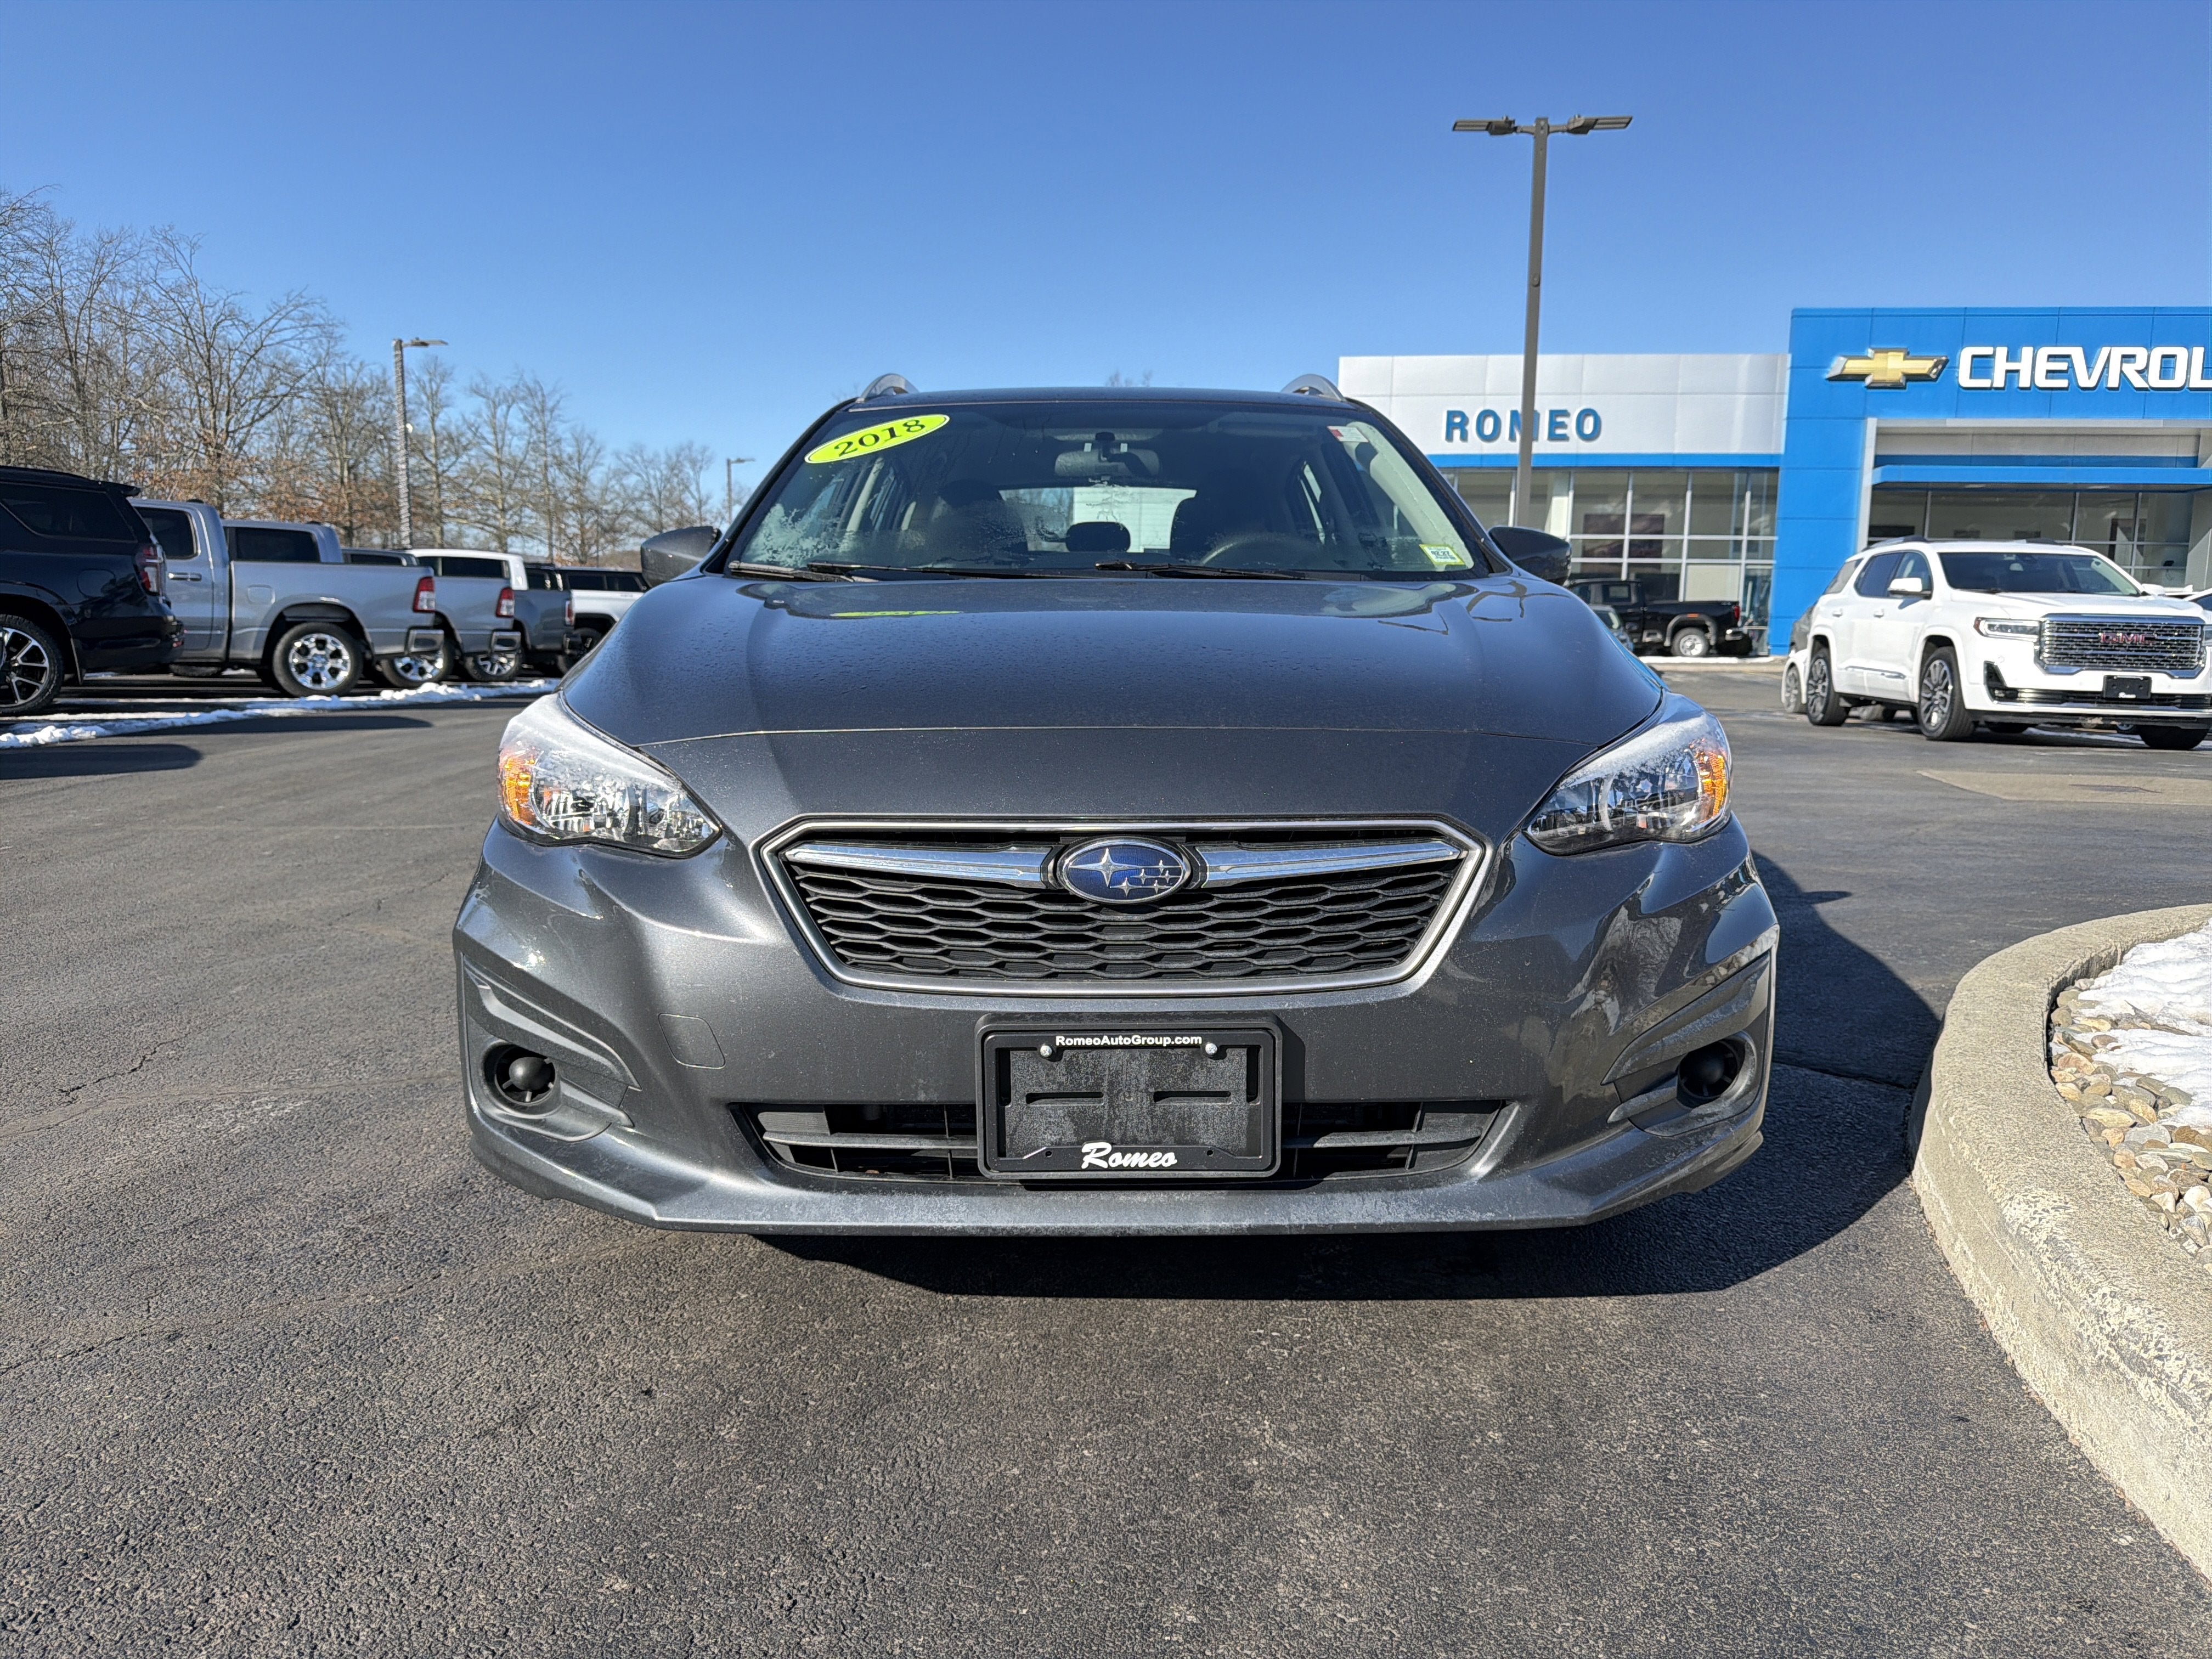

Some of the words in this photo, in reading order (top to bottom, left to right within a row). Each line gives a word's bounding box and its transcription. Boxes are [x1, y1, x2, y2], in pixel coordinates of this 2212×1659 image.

[834, 419, 926, 457] 2018
[1056, 1035, 1202, 1046] RomeoAutoGroup.com
[1081, 1142, 1178, 1169] Romeo
